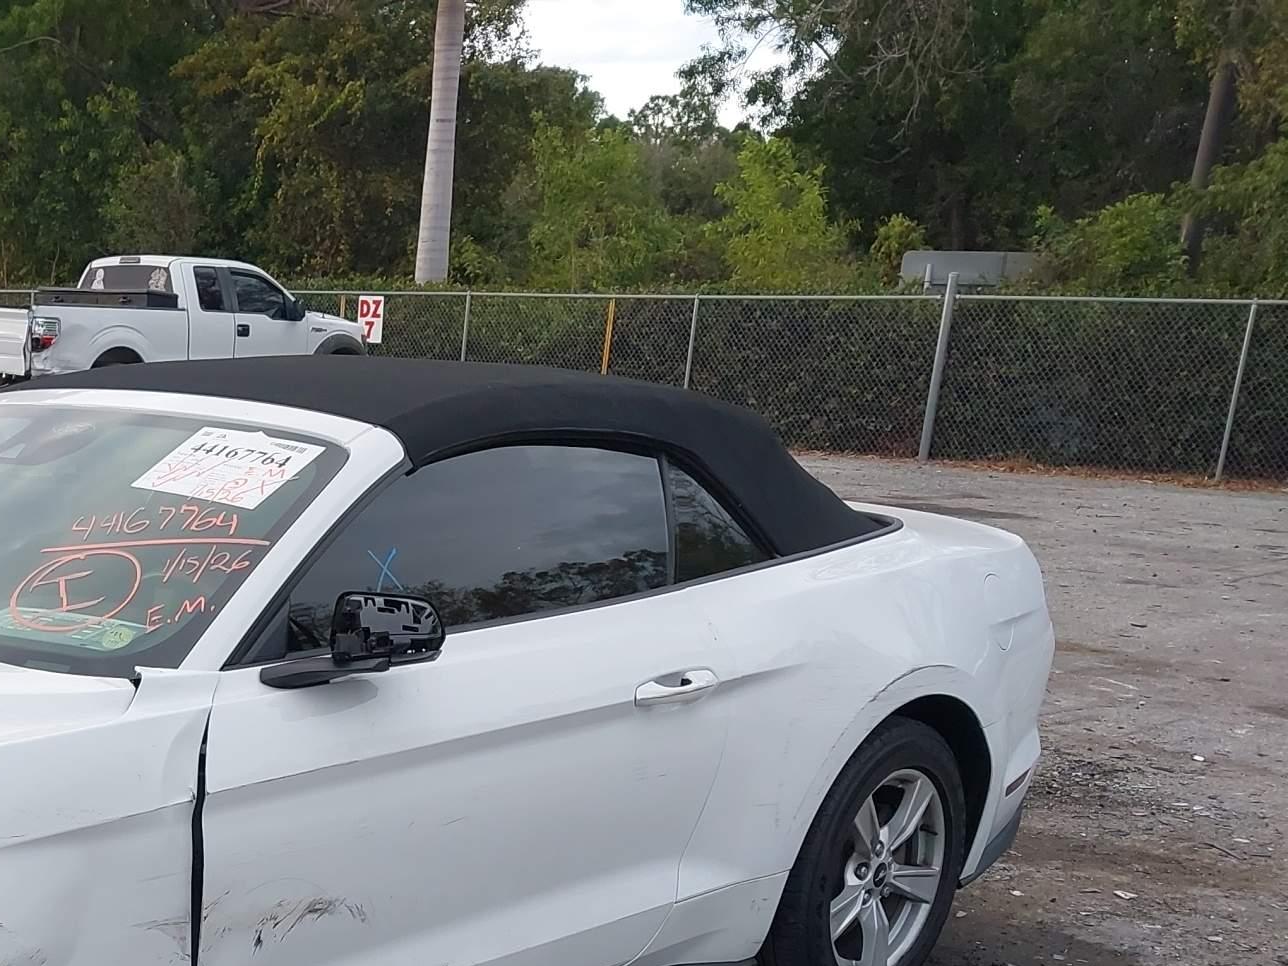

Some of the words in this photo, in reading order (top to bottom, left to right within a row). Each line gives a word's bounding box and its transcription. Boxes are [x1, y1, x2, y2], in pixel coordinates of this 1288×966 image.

[359, 299, 383, 318] DZ
[364, 320, 375, 339] 7
[190, 442, 293, 469] 44167764
